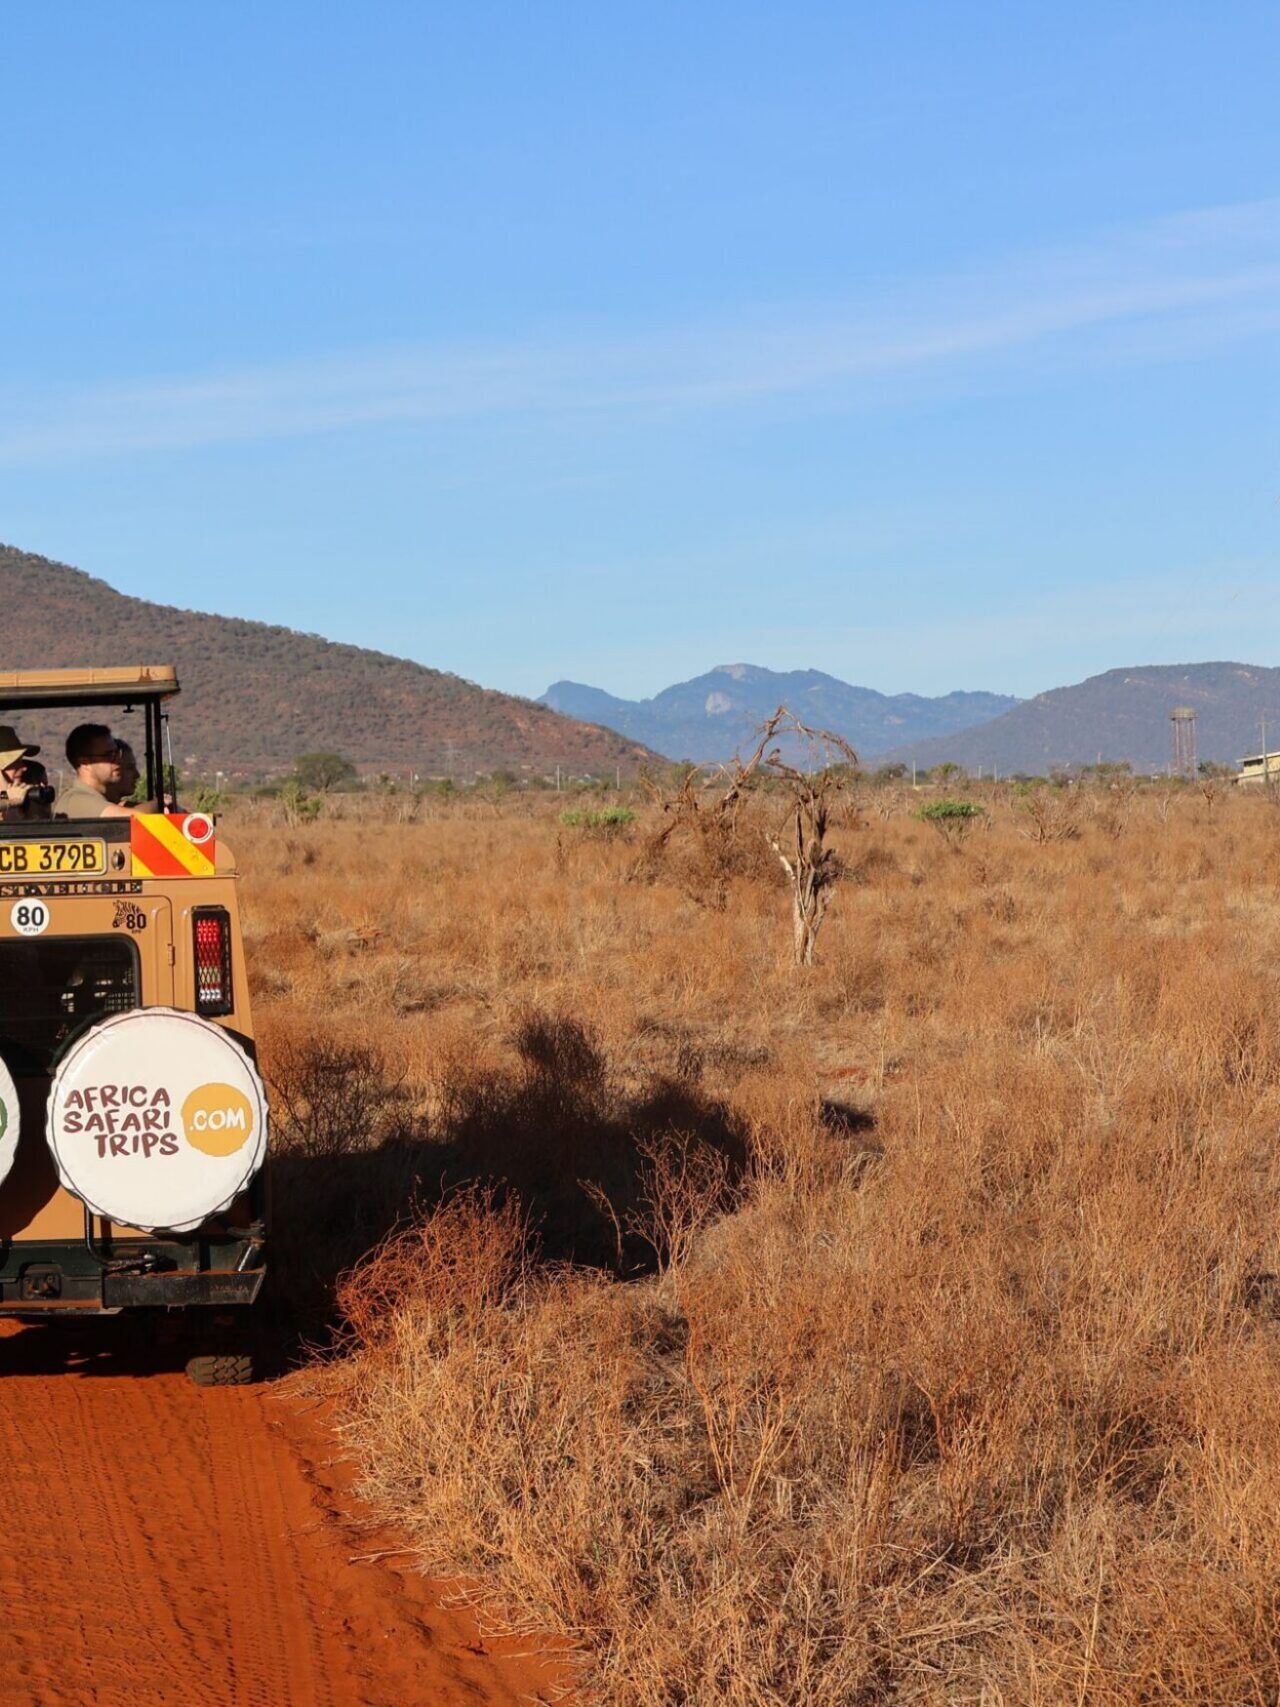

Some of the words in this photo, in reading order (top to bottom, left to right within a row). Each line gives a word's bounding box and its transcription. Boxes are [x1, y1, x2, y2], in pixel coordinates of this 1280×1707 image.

[40, 844, 96, 870] 379B
[17, 906, 44, 926] 80
[126, 913, 147, 929] 80
[63, 1085, 170, 1112] AFRICA
[63, 1109, 170, 1134] SAFARI
[190, 1107, 246, 1131] .COM
[94, 1132, 179, 1158] TRIPS
